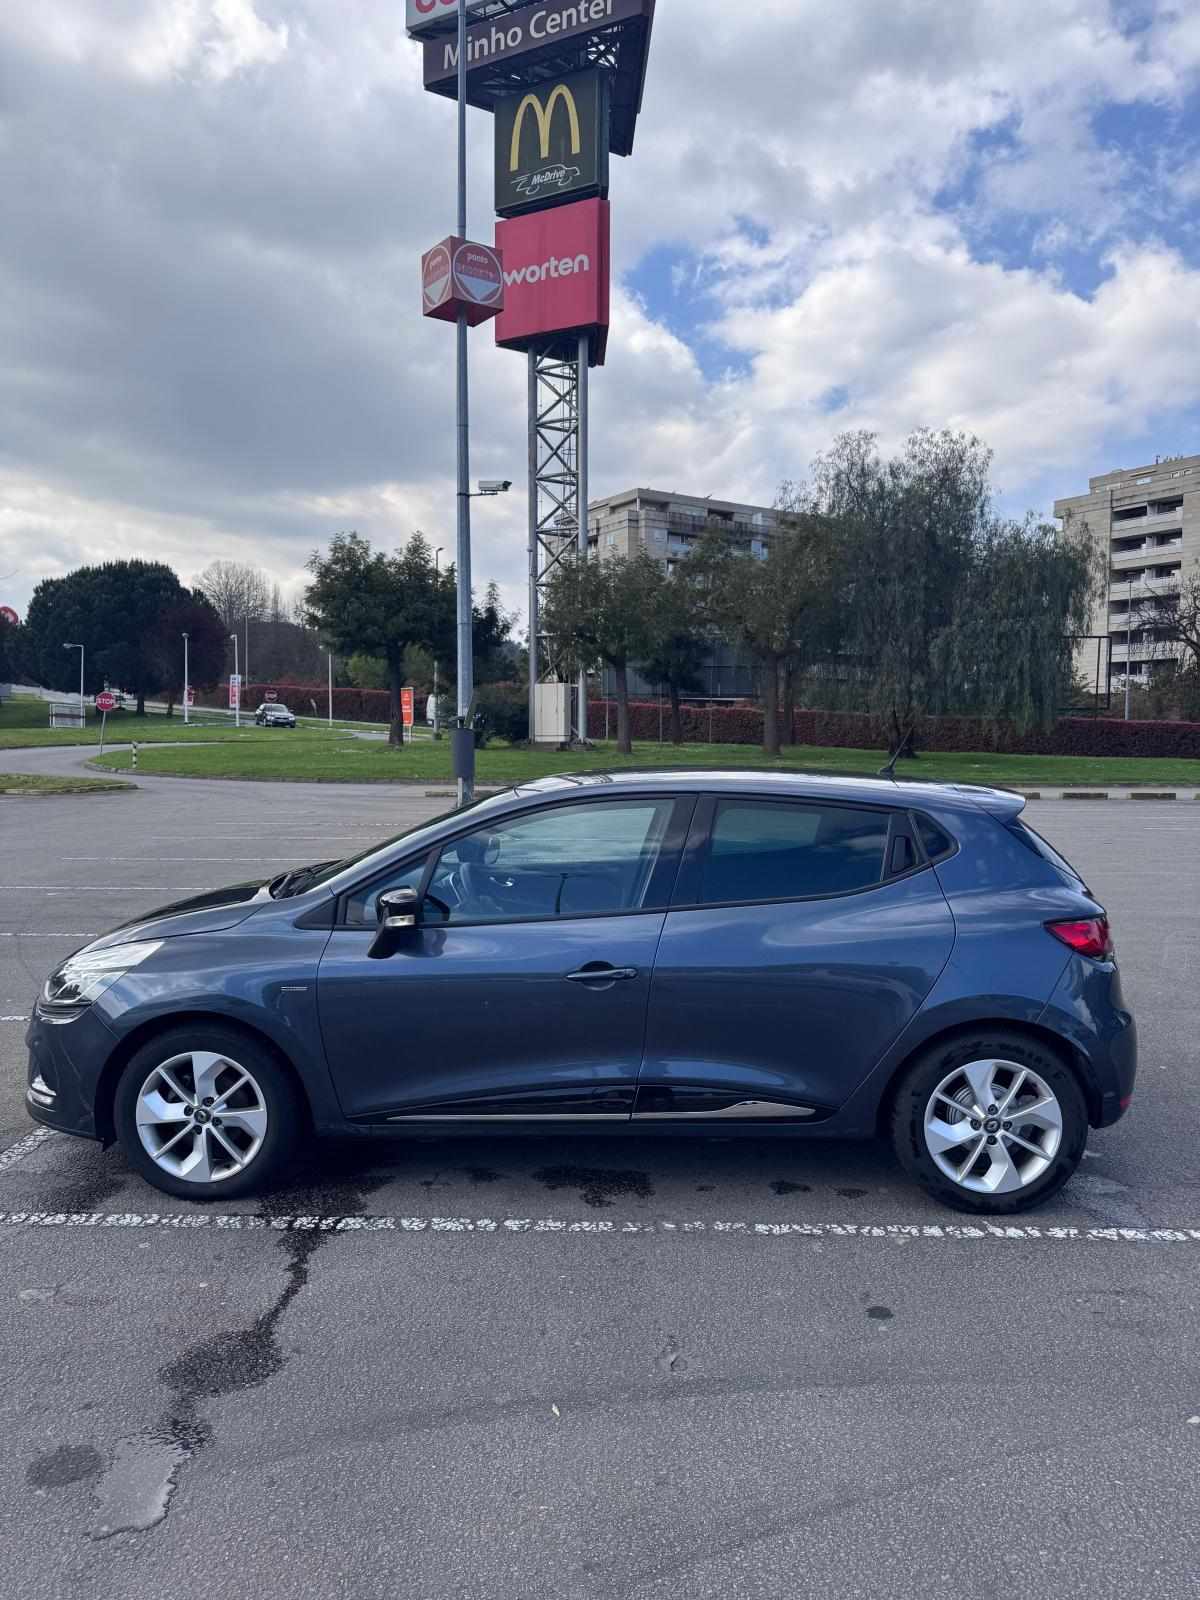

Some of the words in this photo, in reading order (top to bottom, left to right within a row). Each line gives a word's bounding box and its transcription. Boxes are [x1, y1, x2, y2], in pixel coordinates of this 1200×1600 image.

[443, 25, 522, 70] Minho
[531, 169, 566, 185] McDrive
[503, 253, 590, 287] worten
